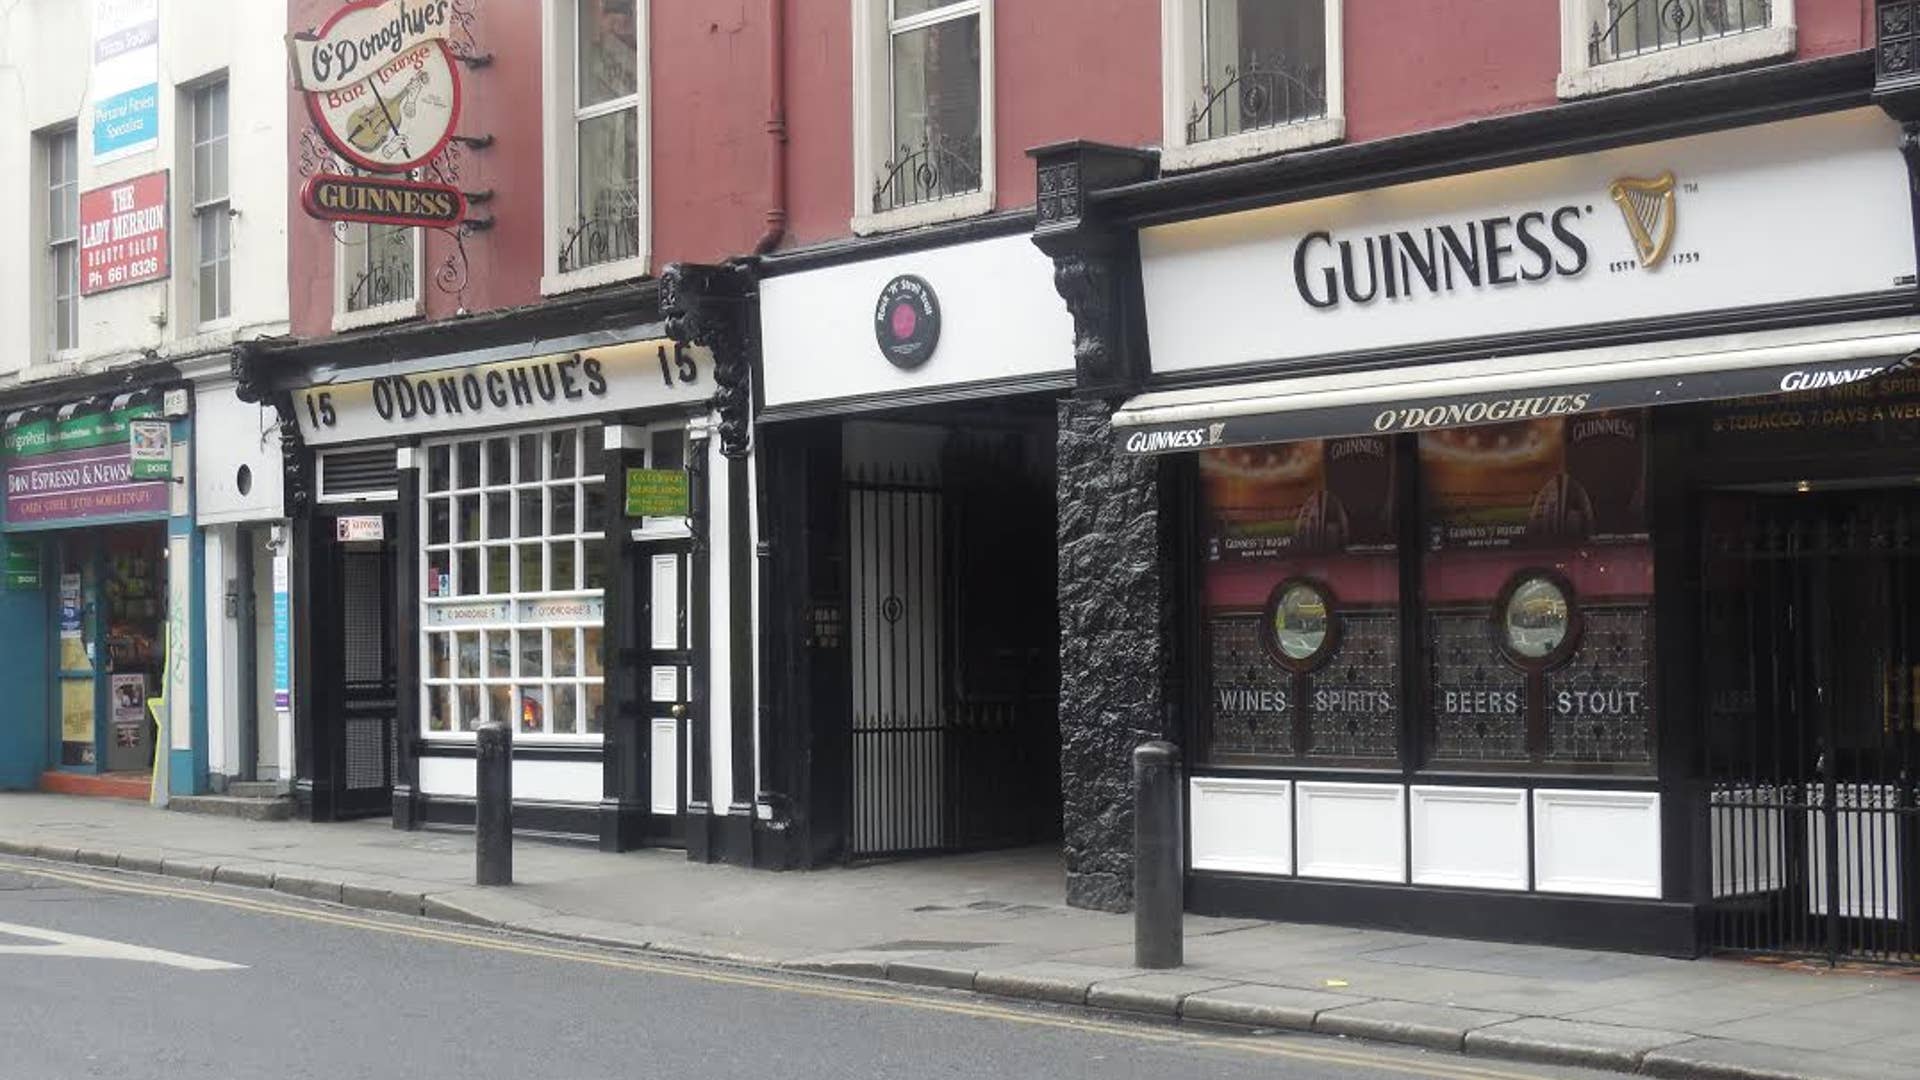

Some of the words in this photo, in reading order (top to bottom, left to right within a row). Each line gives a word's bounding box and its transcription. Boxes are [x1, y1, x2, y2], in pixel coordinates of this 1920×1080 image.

[112, 185, 135, 214] THE
[318, 184, 451, 217] GUINNESS
[82, 222, 111, 248] LADY
[113, 205, 164, 241] MERRION
[88, 270, 103, 288] Ph
[108, 263, 128, 282] 661
[131, 257, 158, 277] 8326
[1293, 205, 1590, 309] GUINNESS
[1672, 252, 1700, 264] 1759
[657, 343, 697, 387] 15
[372, 353, 608, 420] O'DONOGHUE'S
[306, 392, 336, 429] 15
[1374, 393, 1591, 432] O'DONOGHUES
[1823, 405, 1867, 425] DAYS
[1871, 404, 1884, 420] A
[1126, 428, 1204, 452] GUINNESS
[32, 469, 79, 491] ESPRESSO
[82, 465, 92, 485] &
[1219, 690, 1287, 713] WINES
[1315, 689, 1390, 713] SPIRITS
[1445, 691, 1518, 714] BEERS
[1557, 690, 1639, 714] STOUT
